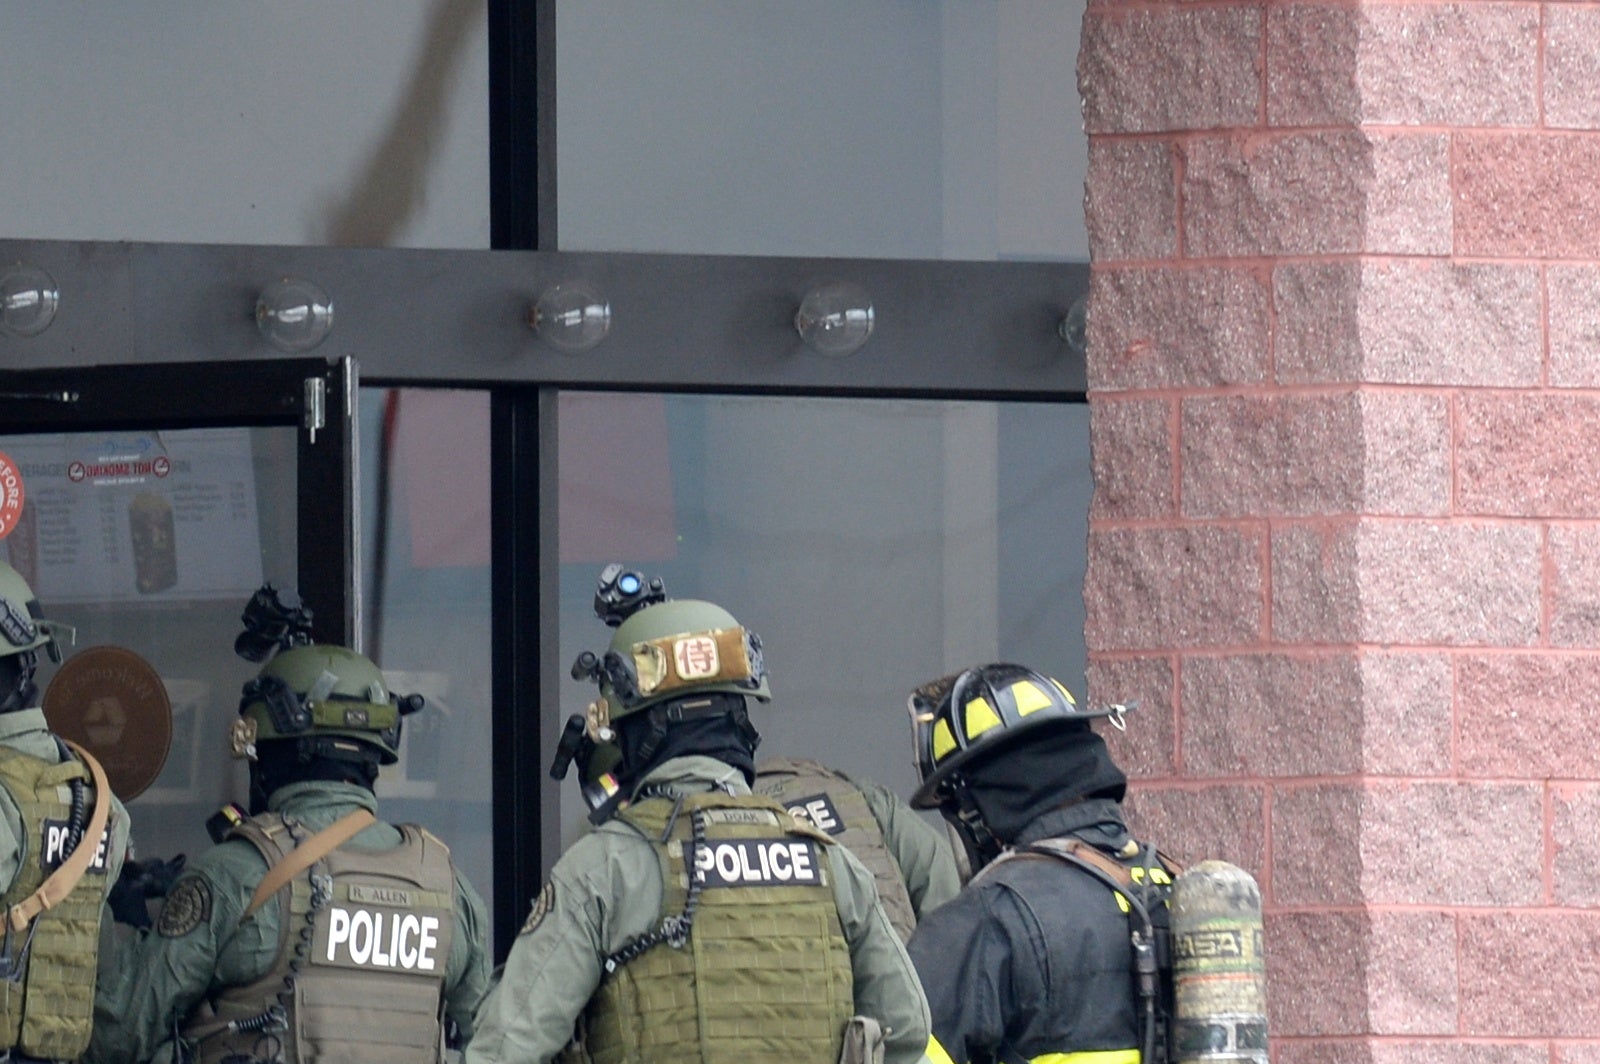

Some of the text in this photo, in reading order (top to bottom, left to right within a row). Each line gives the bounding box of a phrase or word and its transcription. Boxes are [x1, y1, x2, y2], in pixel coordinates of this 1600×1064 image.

[694, 843, 814, 883] POLICE
[373, 889, 407, 904] ALLEN
[327, 908, 439, 970] POLICE
